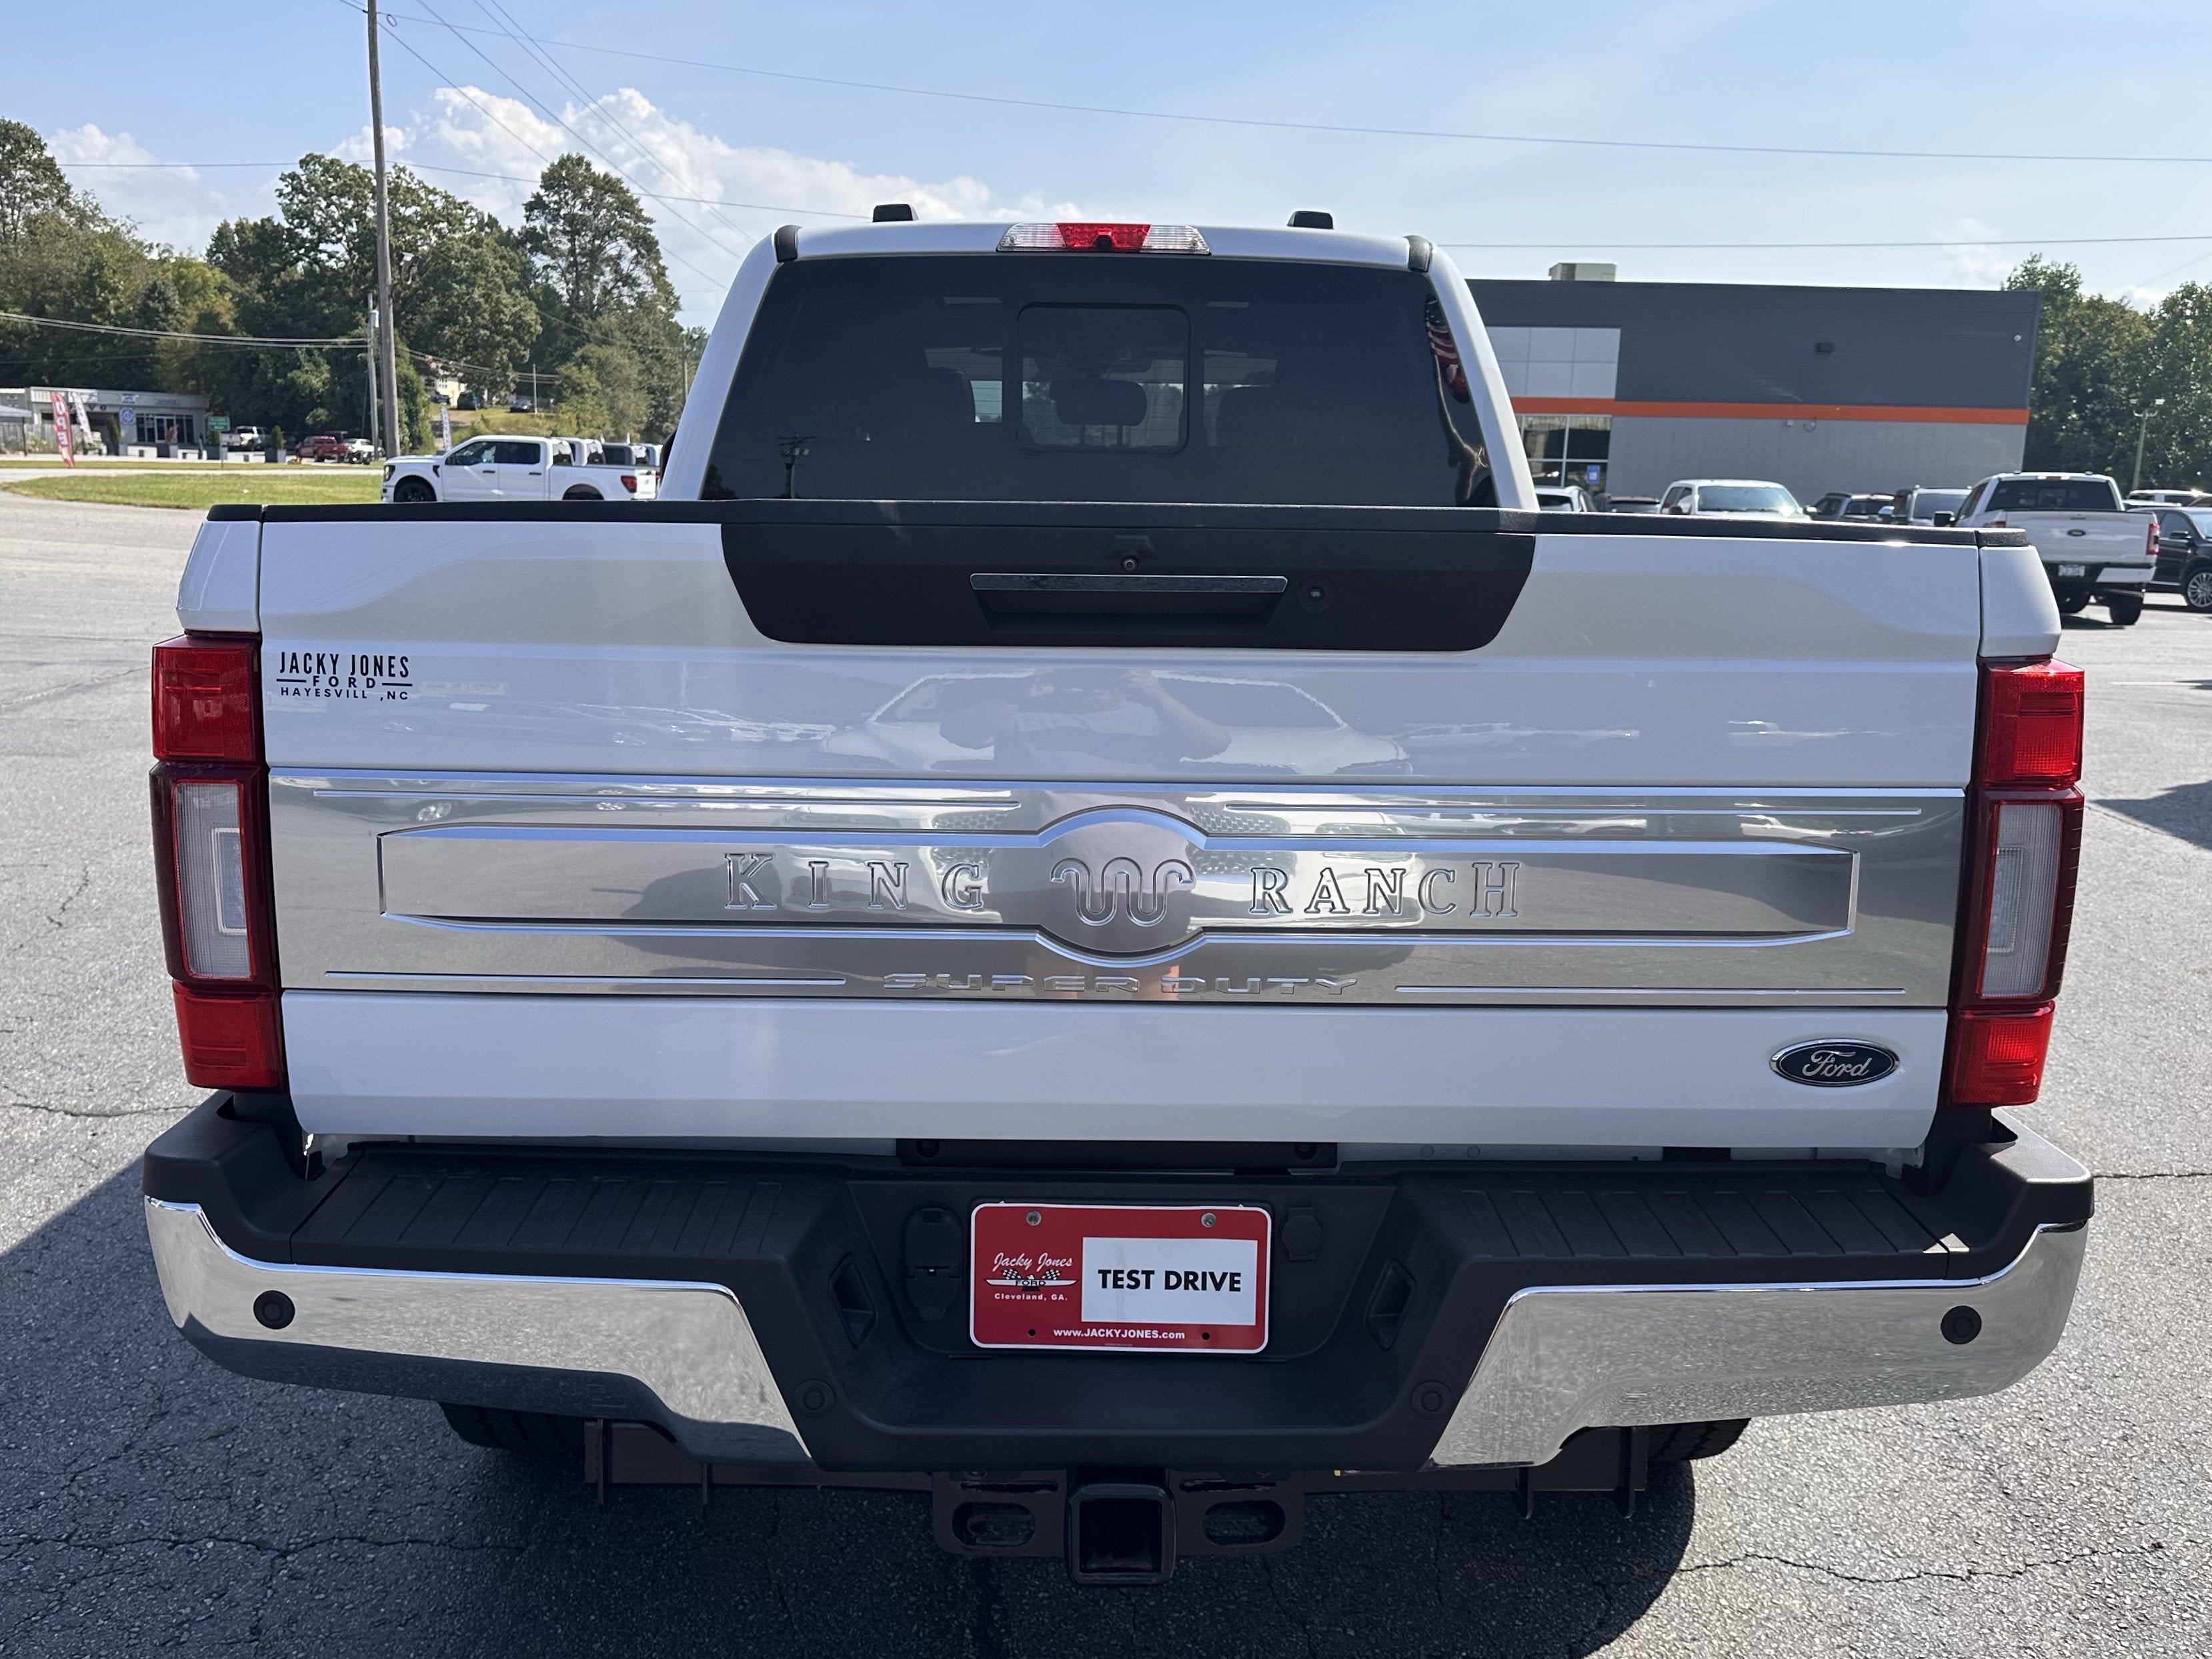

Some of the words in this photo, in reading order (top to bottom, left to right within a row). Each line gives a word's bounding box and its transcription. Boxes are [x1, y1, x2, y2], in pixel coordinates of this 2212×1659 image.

[279, 651, 339, 675] JACKY
[350, 654, 409, 677] JONES
[280, 687, 367, 698] HAYESVILL
[313, 675, 375, 689] FORD
[724, 852, 984, 911] KING
[1248, 862, 1522, 918] RANCH
[882, 973, 1140, 993] SUPER
[1160, 976, 1358, 996] DUTY
[1802, 1050, 1873, 1077] Ford
[992, 1252, 1032, 1272] Jacky
[1036, 1252, 1073, 1272] Jones
[1098, 1269, 1155, 1290] TEST
[1164, 1270, 1241, 1292] DRIVE
[994, 1293, 1047, 1301] Cleveland,
[1053, 1328, 1185, 1340] www.JACKYJONES.com
